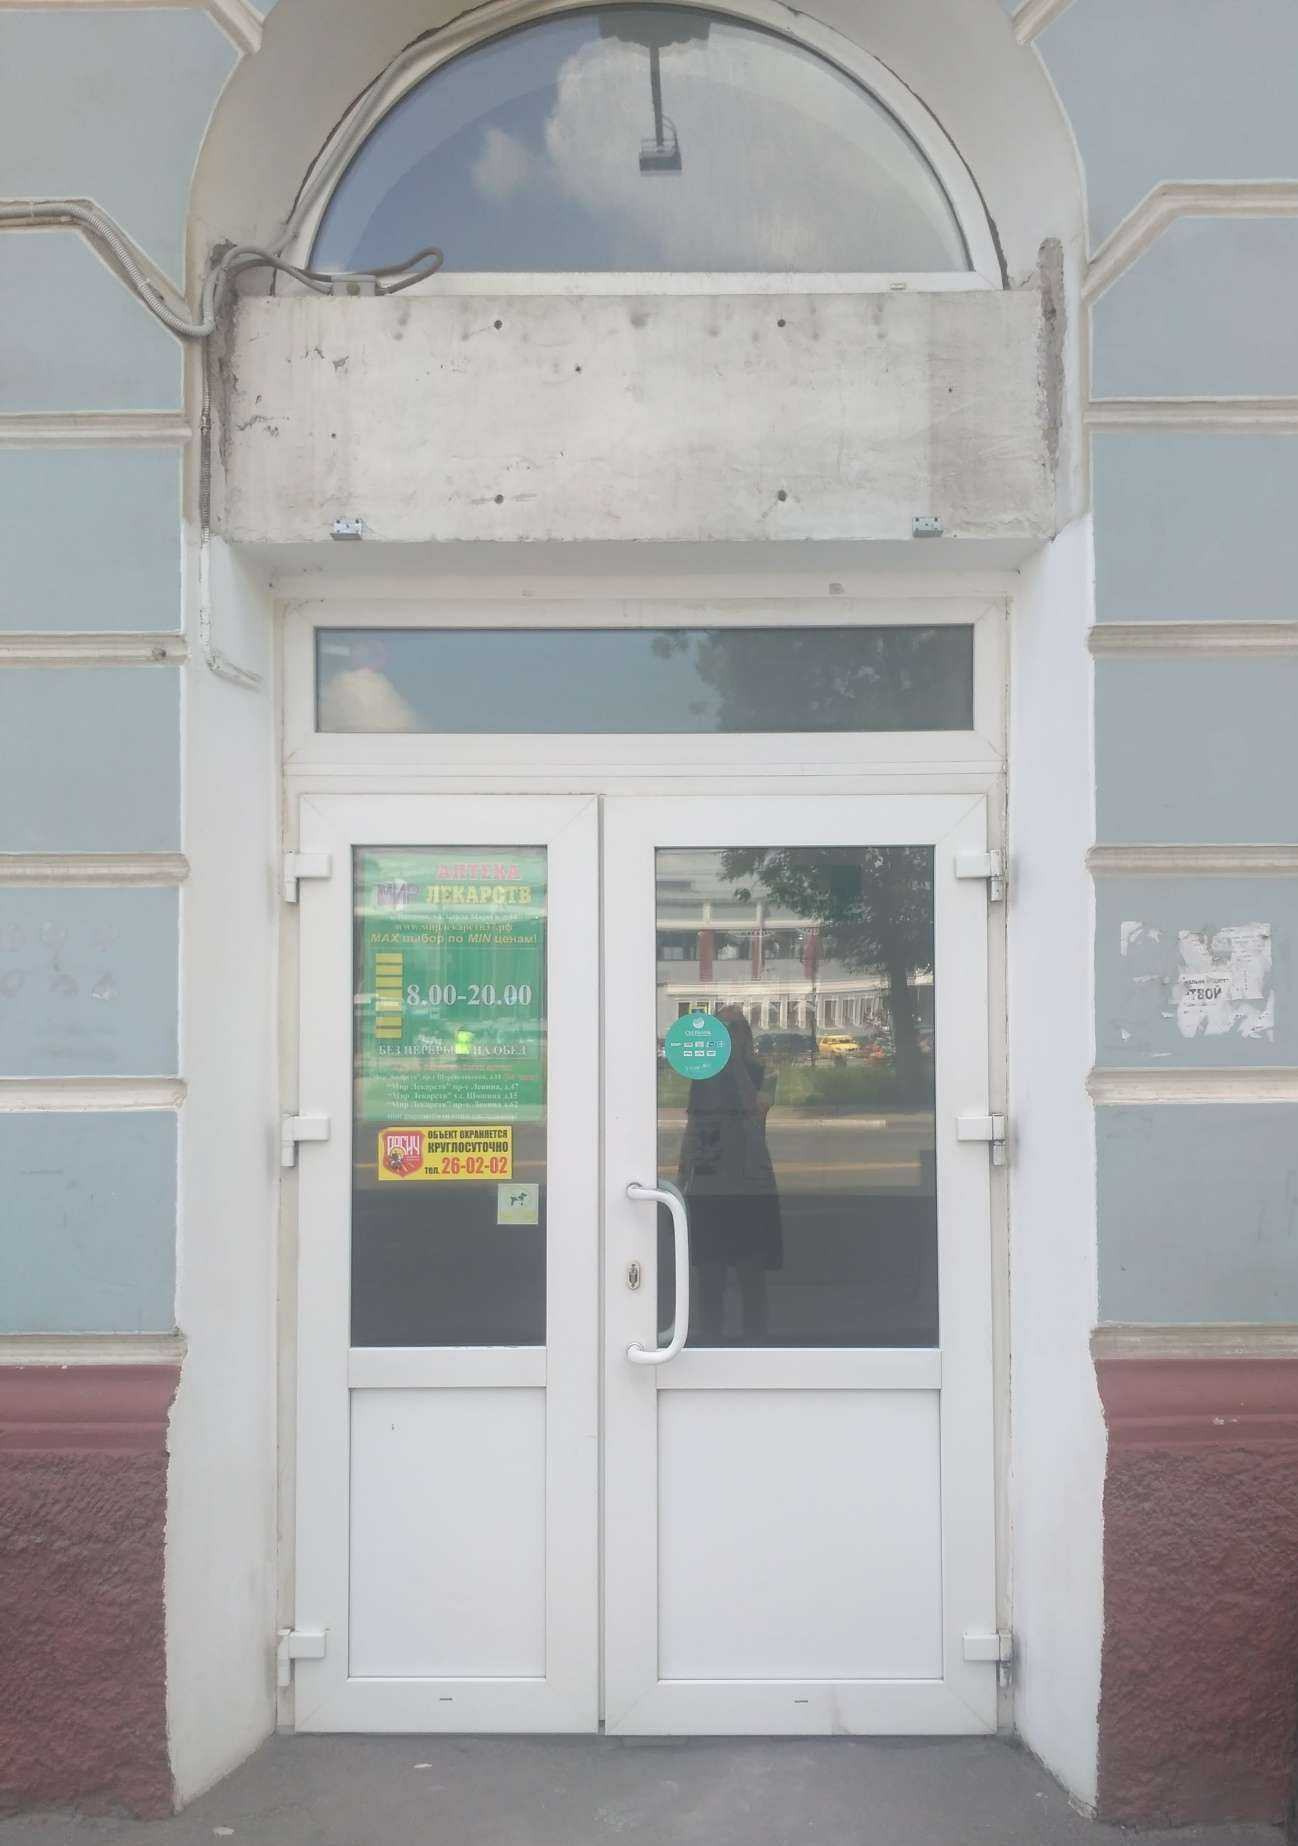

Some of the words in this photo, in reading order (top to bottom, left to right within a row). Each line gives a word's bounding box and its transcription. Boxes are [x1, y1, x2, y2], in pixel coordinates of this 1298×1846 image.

[426, 884, 532, 904] ЛЕКАРСТВ
[448, 935, 465, 944] по
[406, 983, 533, 1007] 8.00-20.00
[427, 1129, 458, 1139] ОБЪЕКТ
[459, 1129, 508, 1139] ОХРАНЯЕТСЯ
[427, 1141, 509, 1153] КРУГЛОСУТОЧНО
[441, 1156, 508, 1175] 26-02-02
